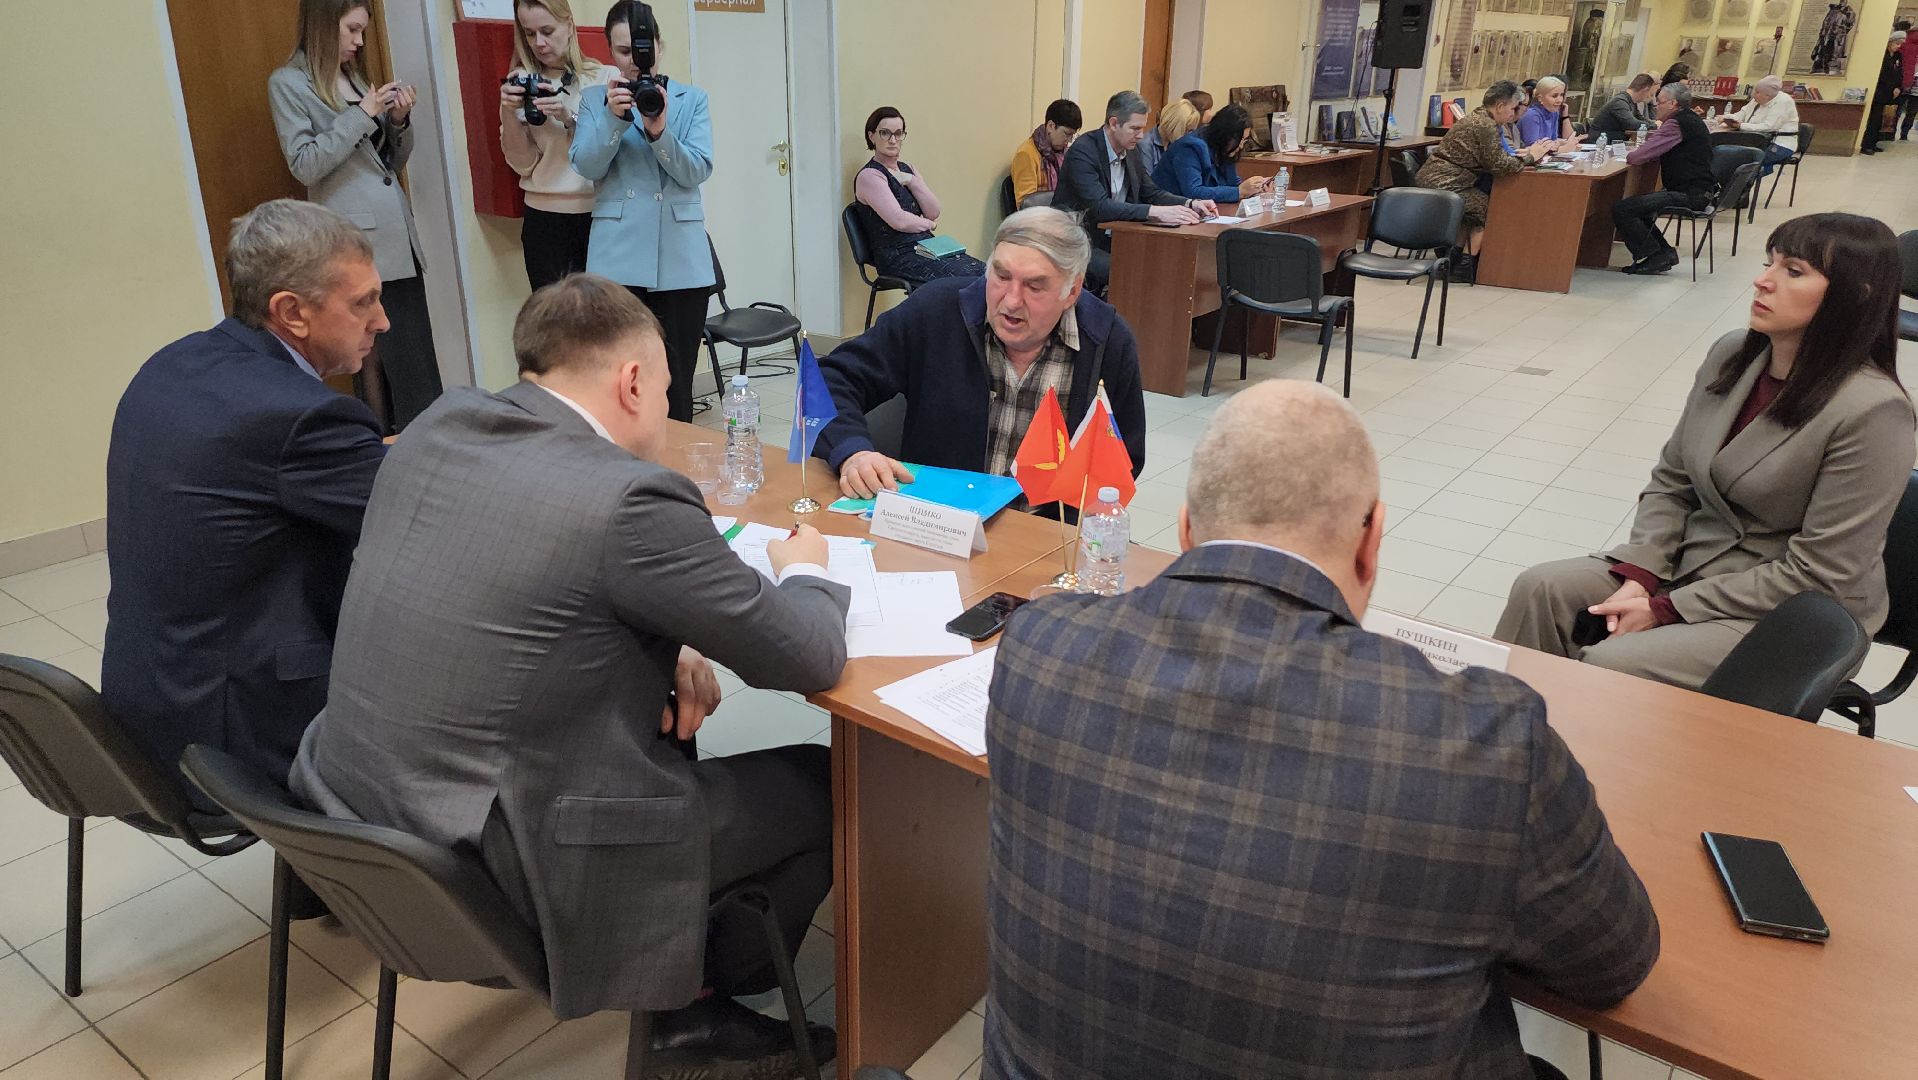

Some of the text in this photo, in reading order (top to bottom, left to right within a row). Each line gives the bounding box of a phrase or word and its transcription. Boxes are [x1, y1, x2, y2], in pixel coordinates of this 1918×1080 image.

[880, 509, 910, 522] Алексей
[911, 515, 967, 537] Владимирович
[1395, 627, 1459, 654] ПУШКИН
